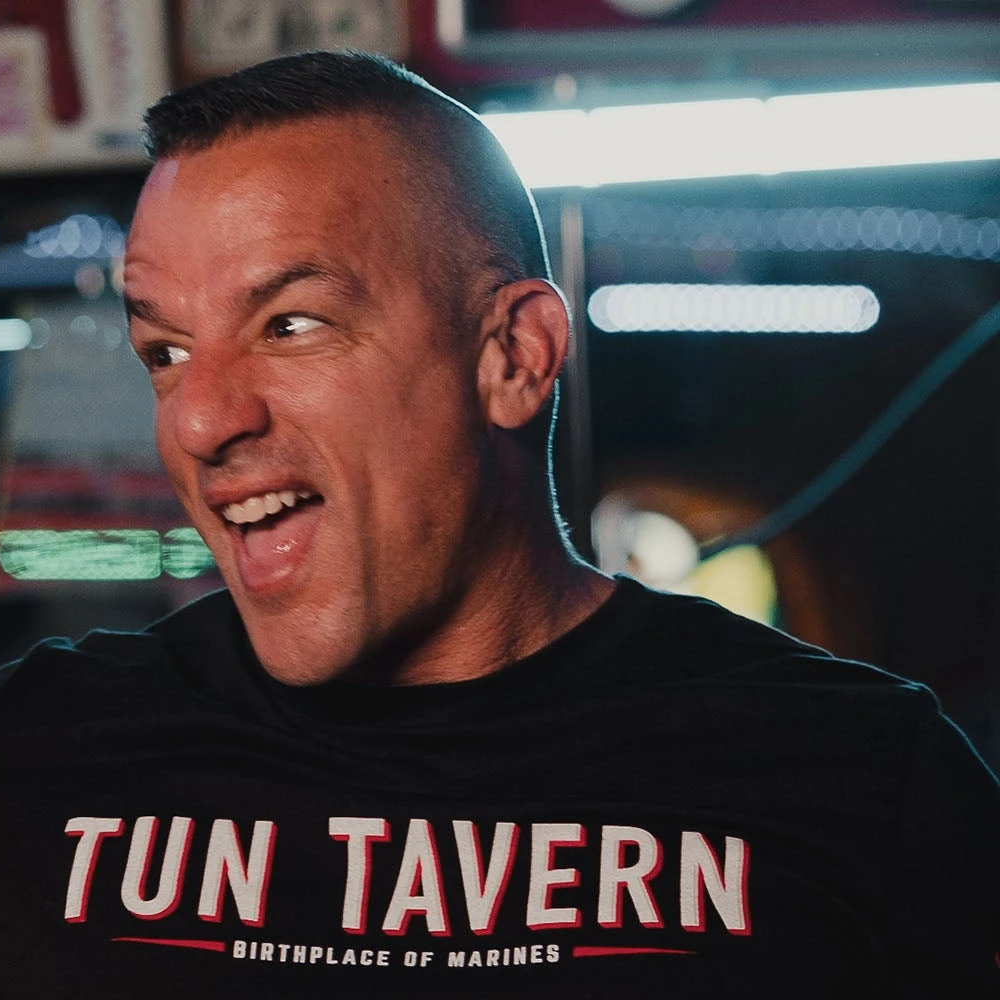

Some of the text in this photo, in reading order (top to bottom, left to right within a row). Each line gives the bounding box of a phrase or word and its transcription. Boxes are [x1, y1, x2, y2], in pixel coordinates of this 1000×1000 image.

[62, 815, 752, 936] TUN TAVERN
[232, 939, 560, 968] BIRTHPLACE OF MARINES
